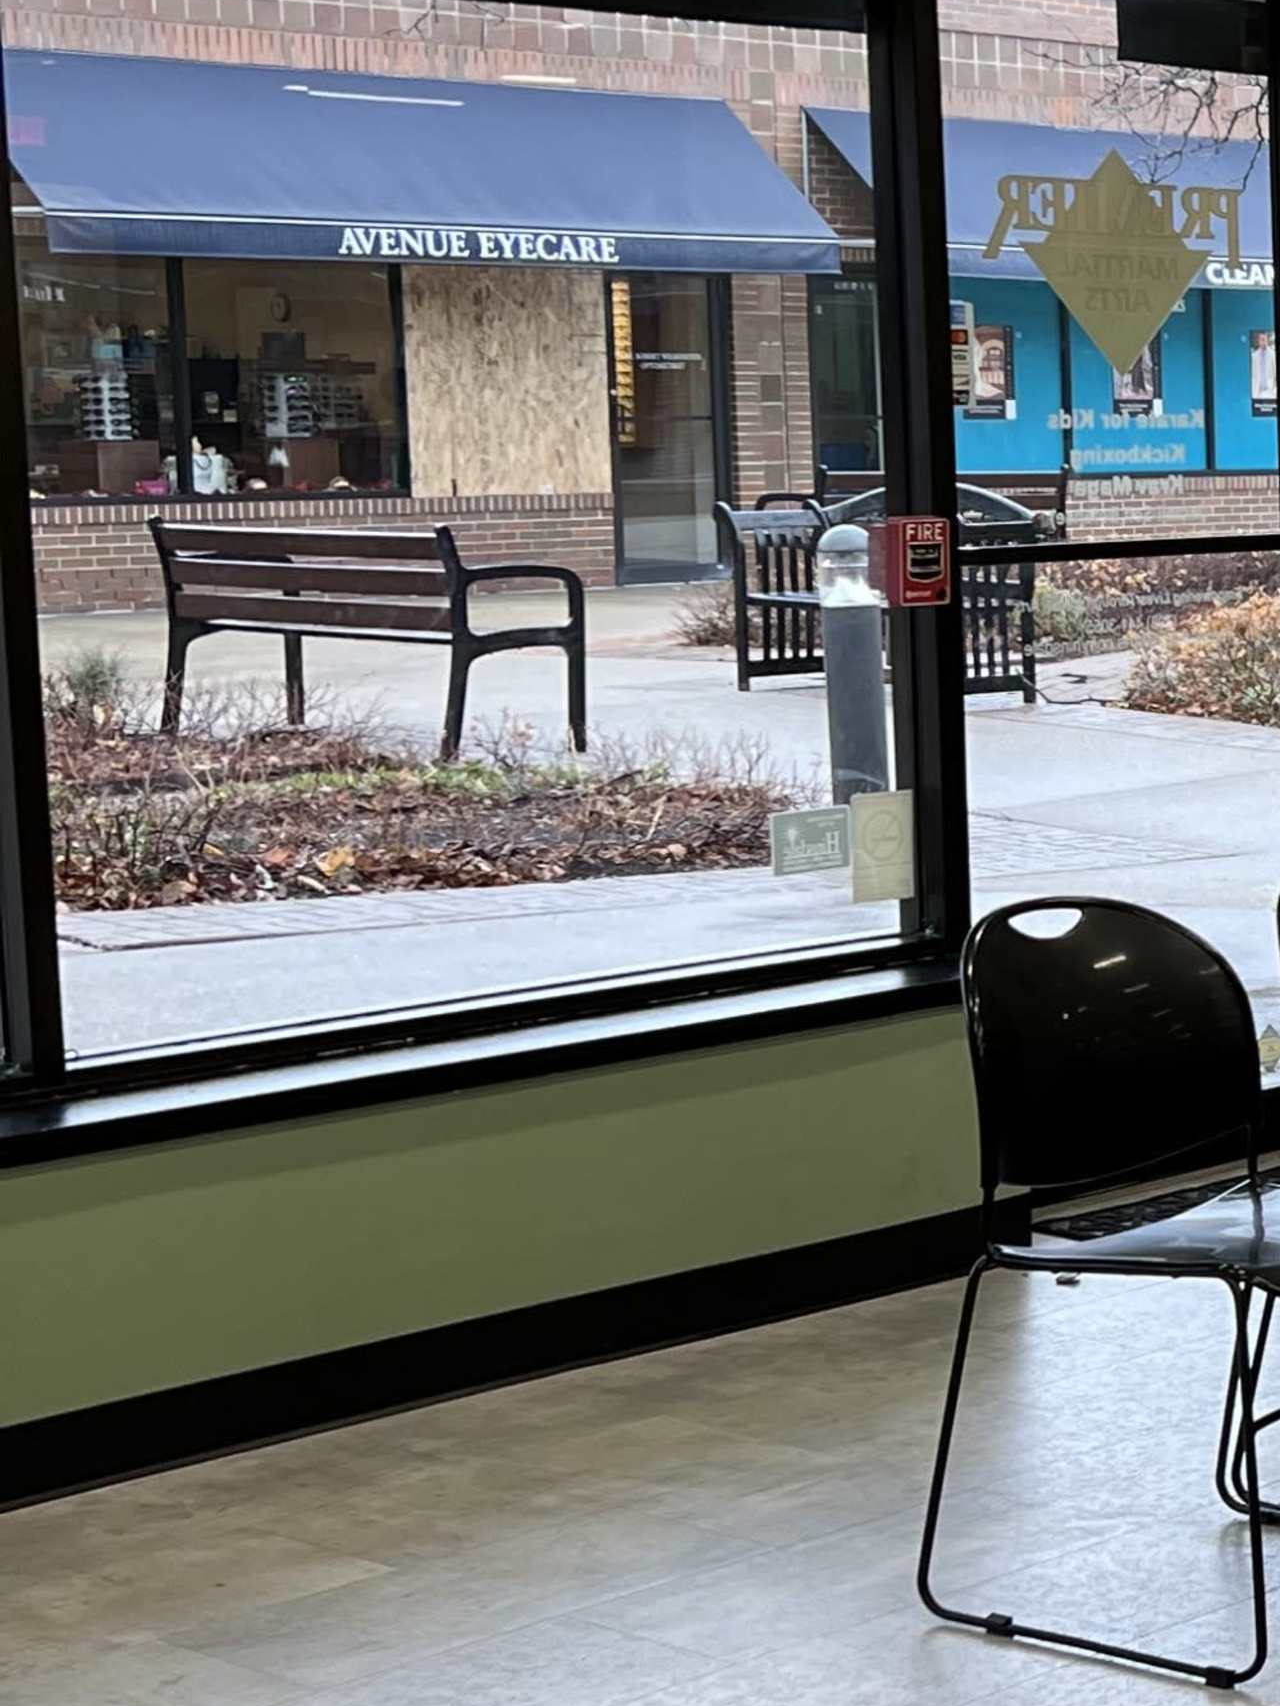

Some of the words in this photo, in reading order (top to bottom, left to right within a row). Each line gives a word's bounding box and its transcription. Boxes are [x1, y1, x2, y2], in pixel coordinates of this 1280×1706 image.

[338, 227, 470, 258] AVENUE
[476, 231, 620, 263] EYECARE
[905, 522, 945, 542] FIRE
